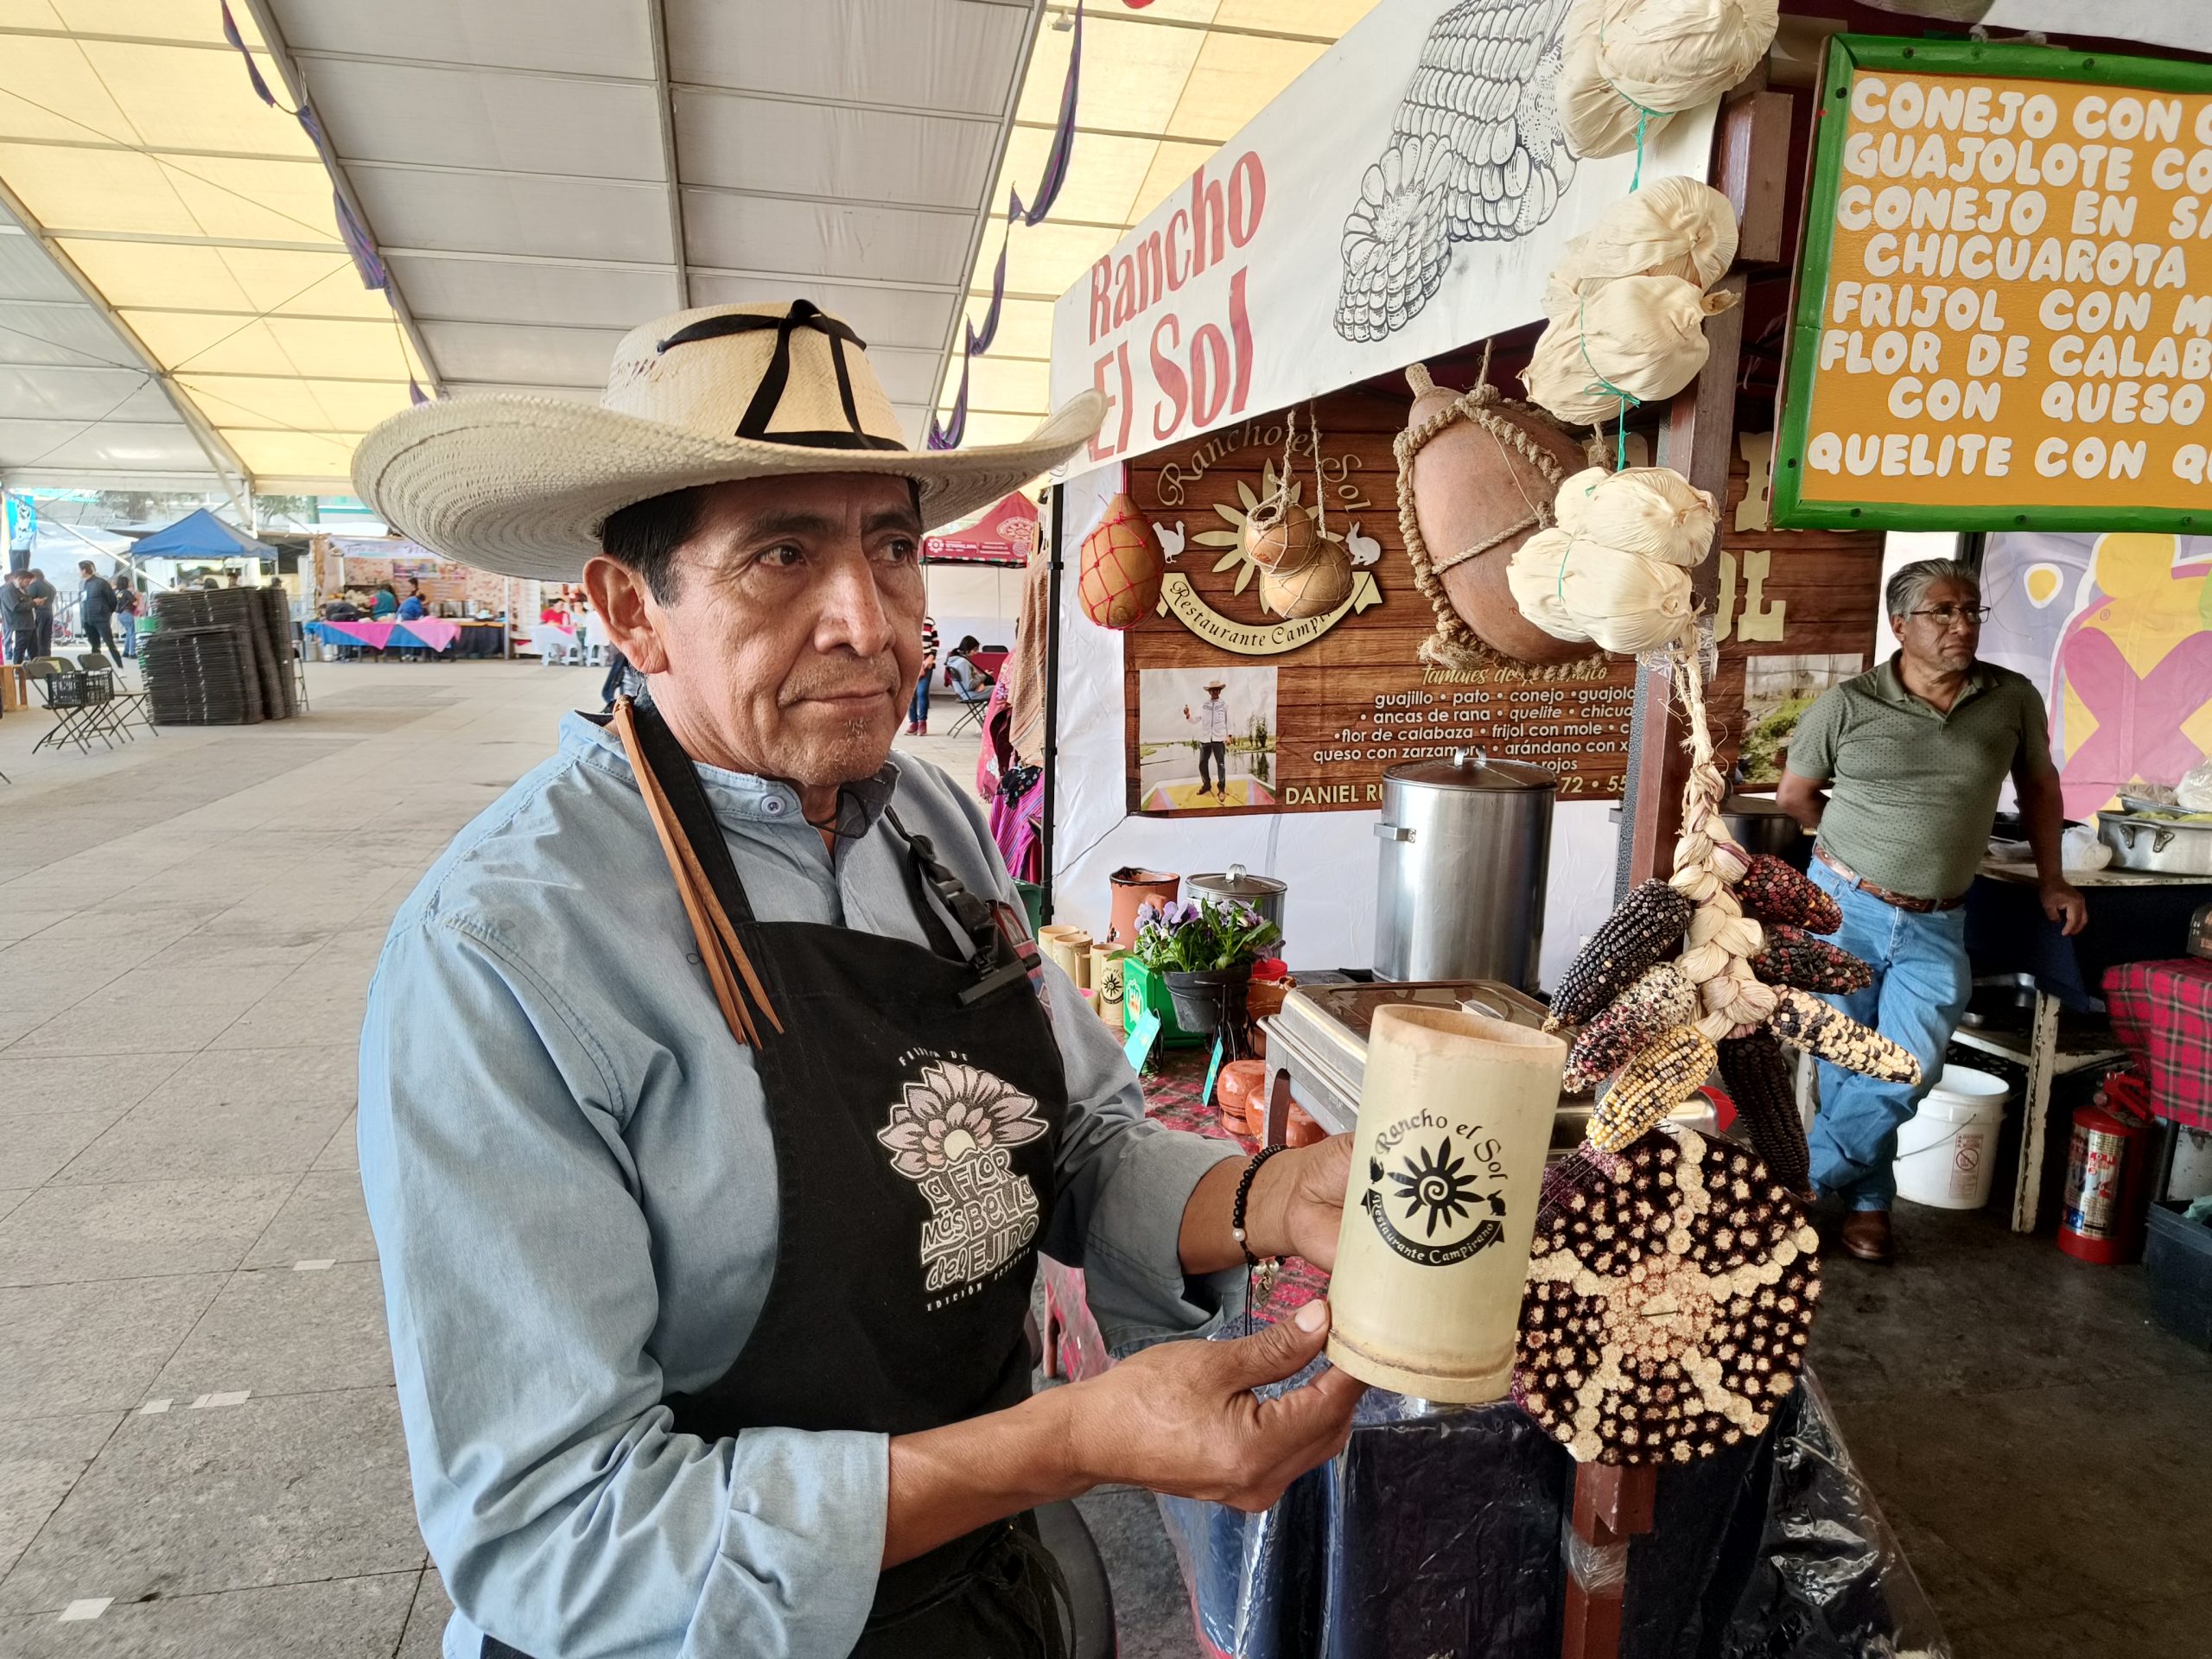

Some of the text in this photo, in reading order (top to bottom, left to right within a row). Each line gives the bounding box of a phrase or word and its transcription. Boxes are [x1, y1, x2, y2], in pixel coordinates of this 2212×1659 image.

[1851, 78, 2057, 139] CONEJO
[2073, 95, 2183, 143] CON
[1843, 131, 2133, 192] GUAJOLOTE
[1837, 185, 2047, 236] CONEJO
[2071, 191, 2138, 238] EN
[1090, 150, 1267, 346] Rancho
[1864, 232, 2186, 289] CHICUAROTA
[1832, 282, 2005, 332] FRIJOL
[2038, 289, 2152, 334] CON
[1089, 265, 1254, 463] El Sol
[1820, 329, 1942, 375] FLOR
[1966, 334, 2031, 378] DE
[1887, 377, 2206, 426] CON QUESO
[1157, 418, 1372, 514] Rancho el Sol
[1808, 432, 2212, 485] QUELITE CON Q
[1169, 581, 1266, 647] Restaurante
[1373, 710, 1424, 724] ancas
[1427, 709, 1449, 723] de
[1452, 709, 1491, 722] rana
[1510, 704, 1562, 722] quelite
[1375, 690, 1433, 709] guajillo
[1452, 689, 1491, 707] pato
[1510, 688, 1565, 705] conejo
[1313, 747, 1362, 764] queso
[1366, 746, 1397, 760] con
[1504, 739, 1581, 755] arándano
[1586, 740, 1615, 753] con
[1341, 728, 1367, 743] flor
[1370, 728, 1393, 741] de
[1397, 725, 1473, 741] calabaza
[1491, 722, 1524, 741] frijol
[1529, 724, 1559, 738] con
[1563, 721, 1603, 736] mole
[1285, 785, 1359, 805] DANIEL
[1560, 776, 1584, 793] 72
[1541, 758, 1578, 774] rojos
[1374, 1108, 1509, 1181] Rancho el Sol
[925, 1247, 969, 1292] del
[967, 1214, 1040, 1282] EJIDO
[1370, 1193, 1494, 1264] Restaurante Campirano
